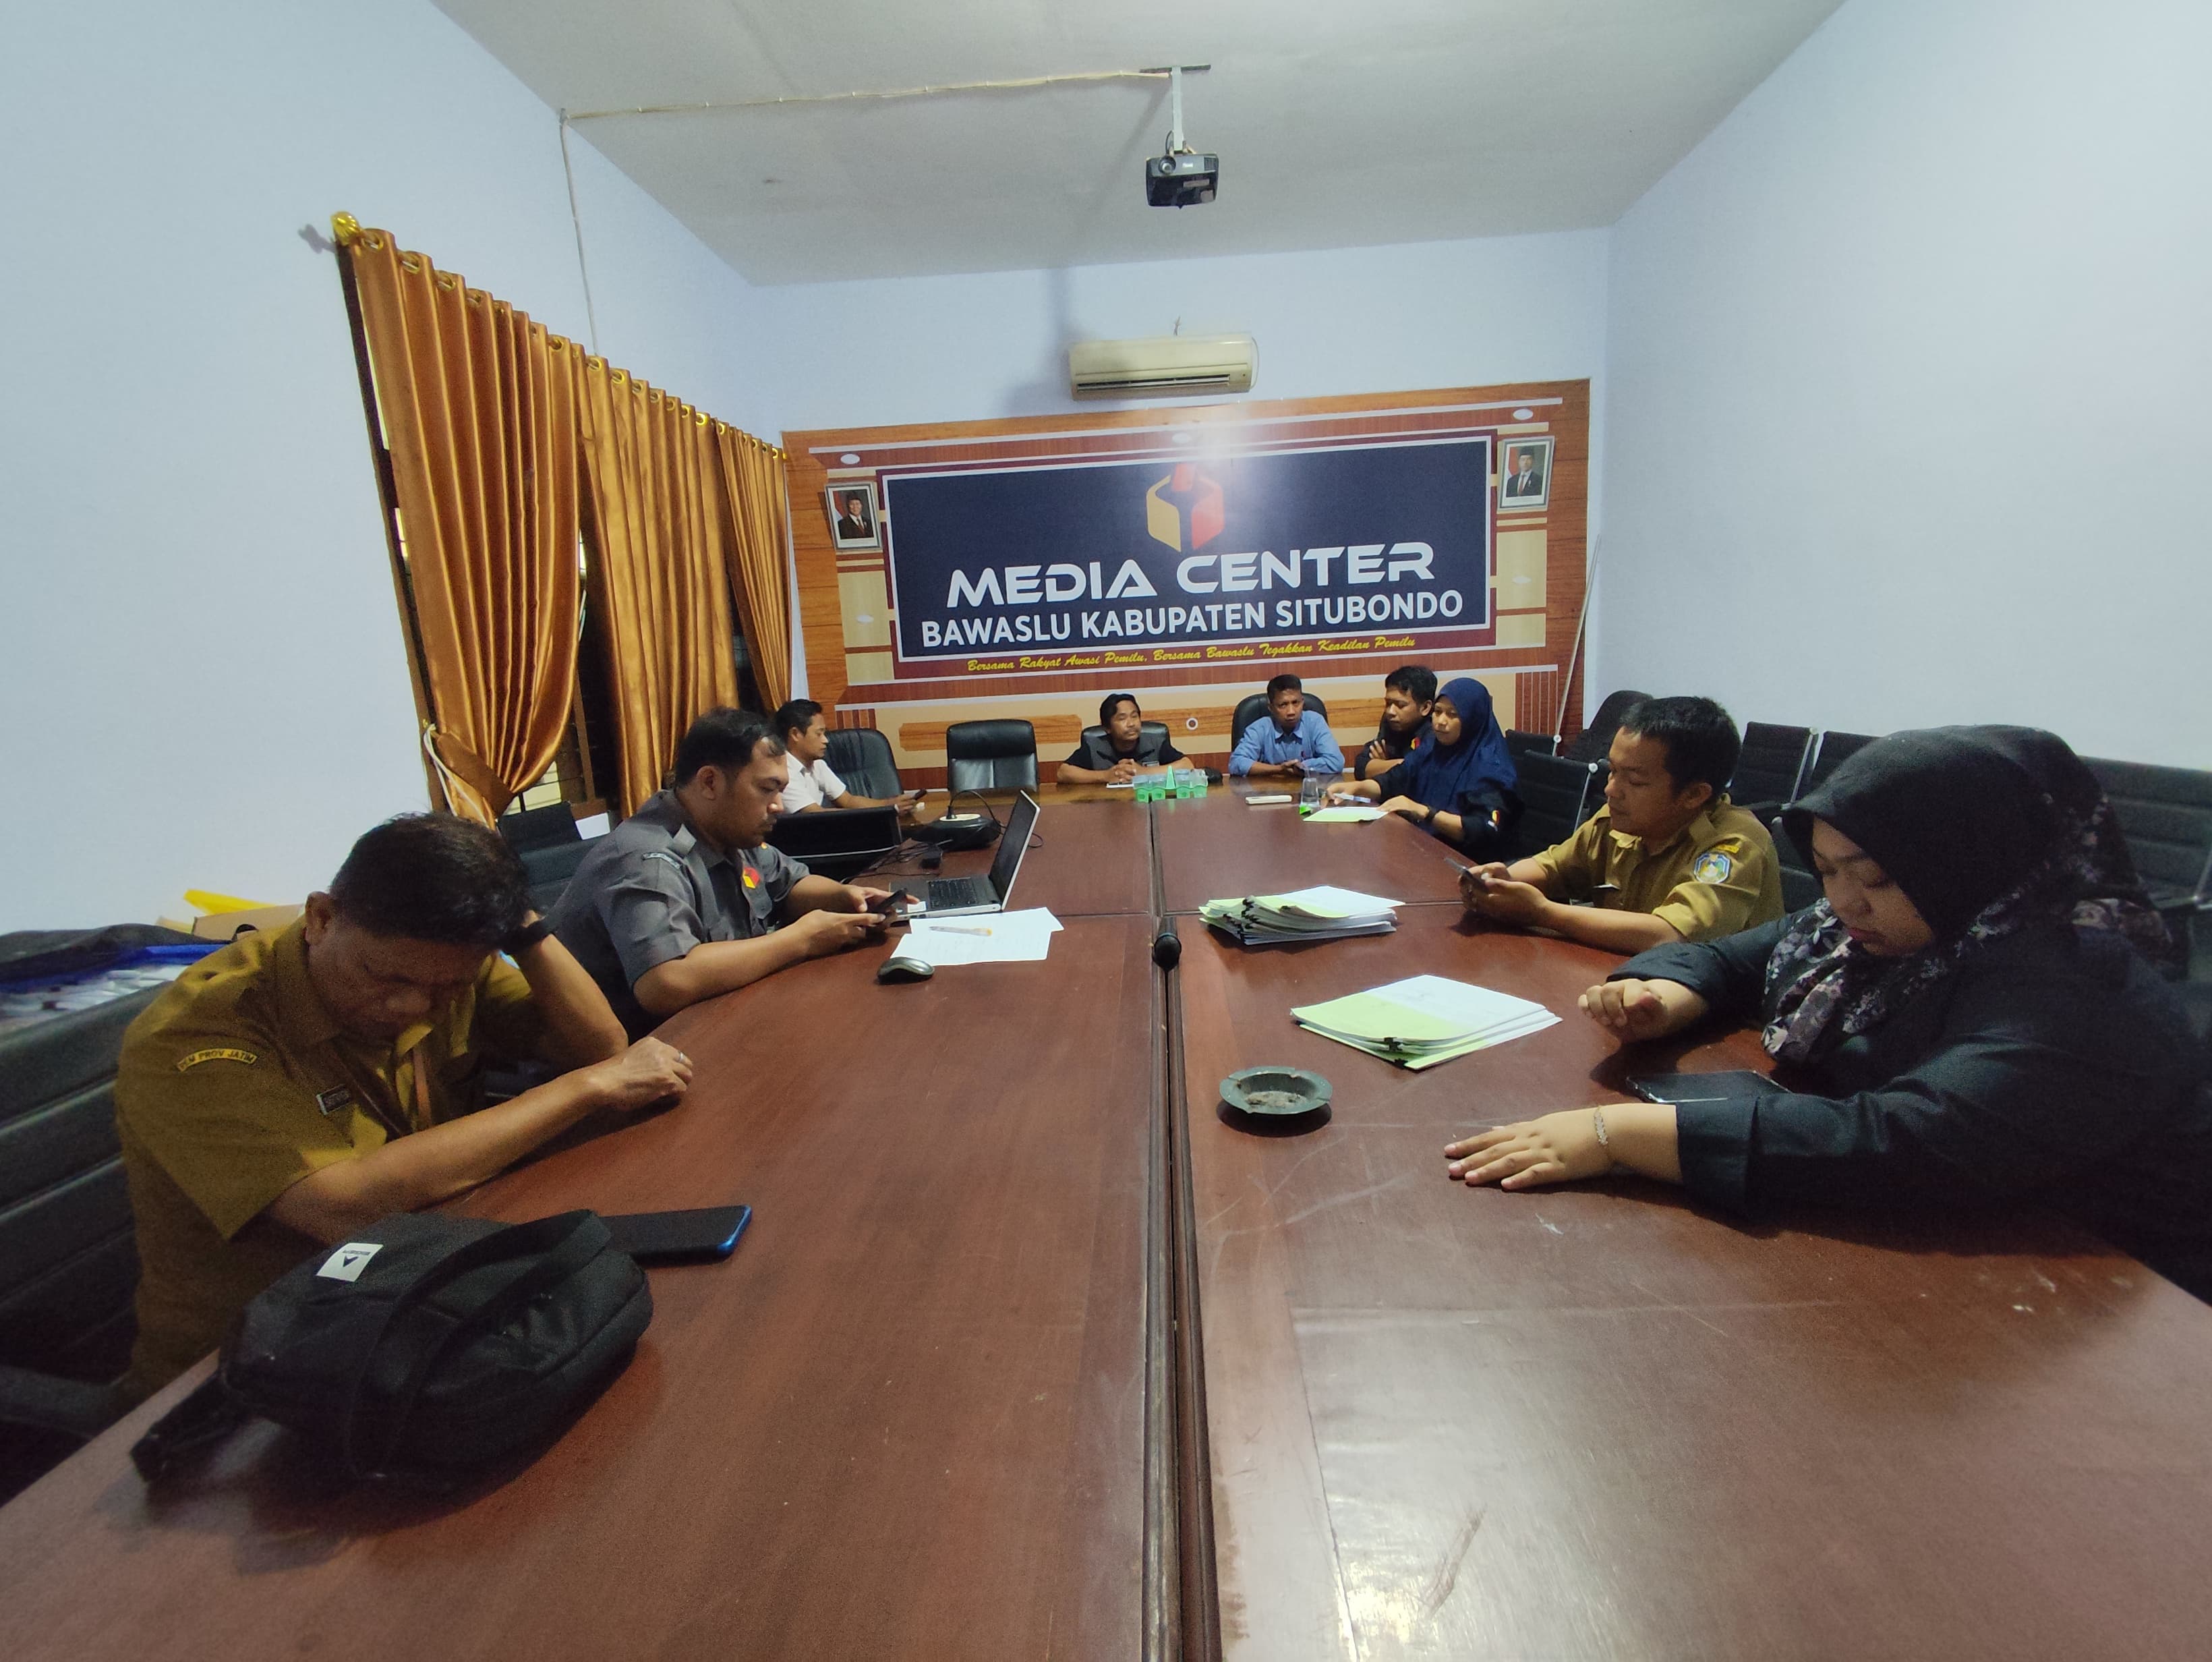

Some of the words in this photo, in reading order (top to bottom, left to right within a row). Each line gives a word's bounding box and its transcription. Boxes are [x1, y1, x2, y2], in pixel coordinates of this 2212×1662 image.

[947, 559, 1158, 608] MEDIA
[1176, 542, 1435, 594] CENTER
[922, 612, 1071, 648] BAWASLU
[1081, 601, 1266, 639] KABUPATEN
[1275, 590, 1463, 628] SITUBONDO
[967, 660, 1015, 671] Bersama
[1019, 656, 1061, 669] Rakyat
[1064, 654, 1100, 666] Awasi
[1104, 651, 1147, 664] Pemilu,
[1153, 649, 1201, 661] Bersama
[1206, 646, 1254, 658] Bawaslu
[1259, 643, 1312, 658] Tegakkan
[1317, 639, 1370, 652] Keadilan
[1374, 635, 1416, 648] Pemilu
